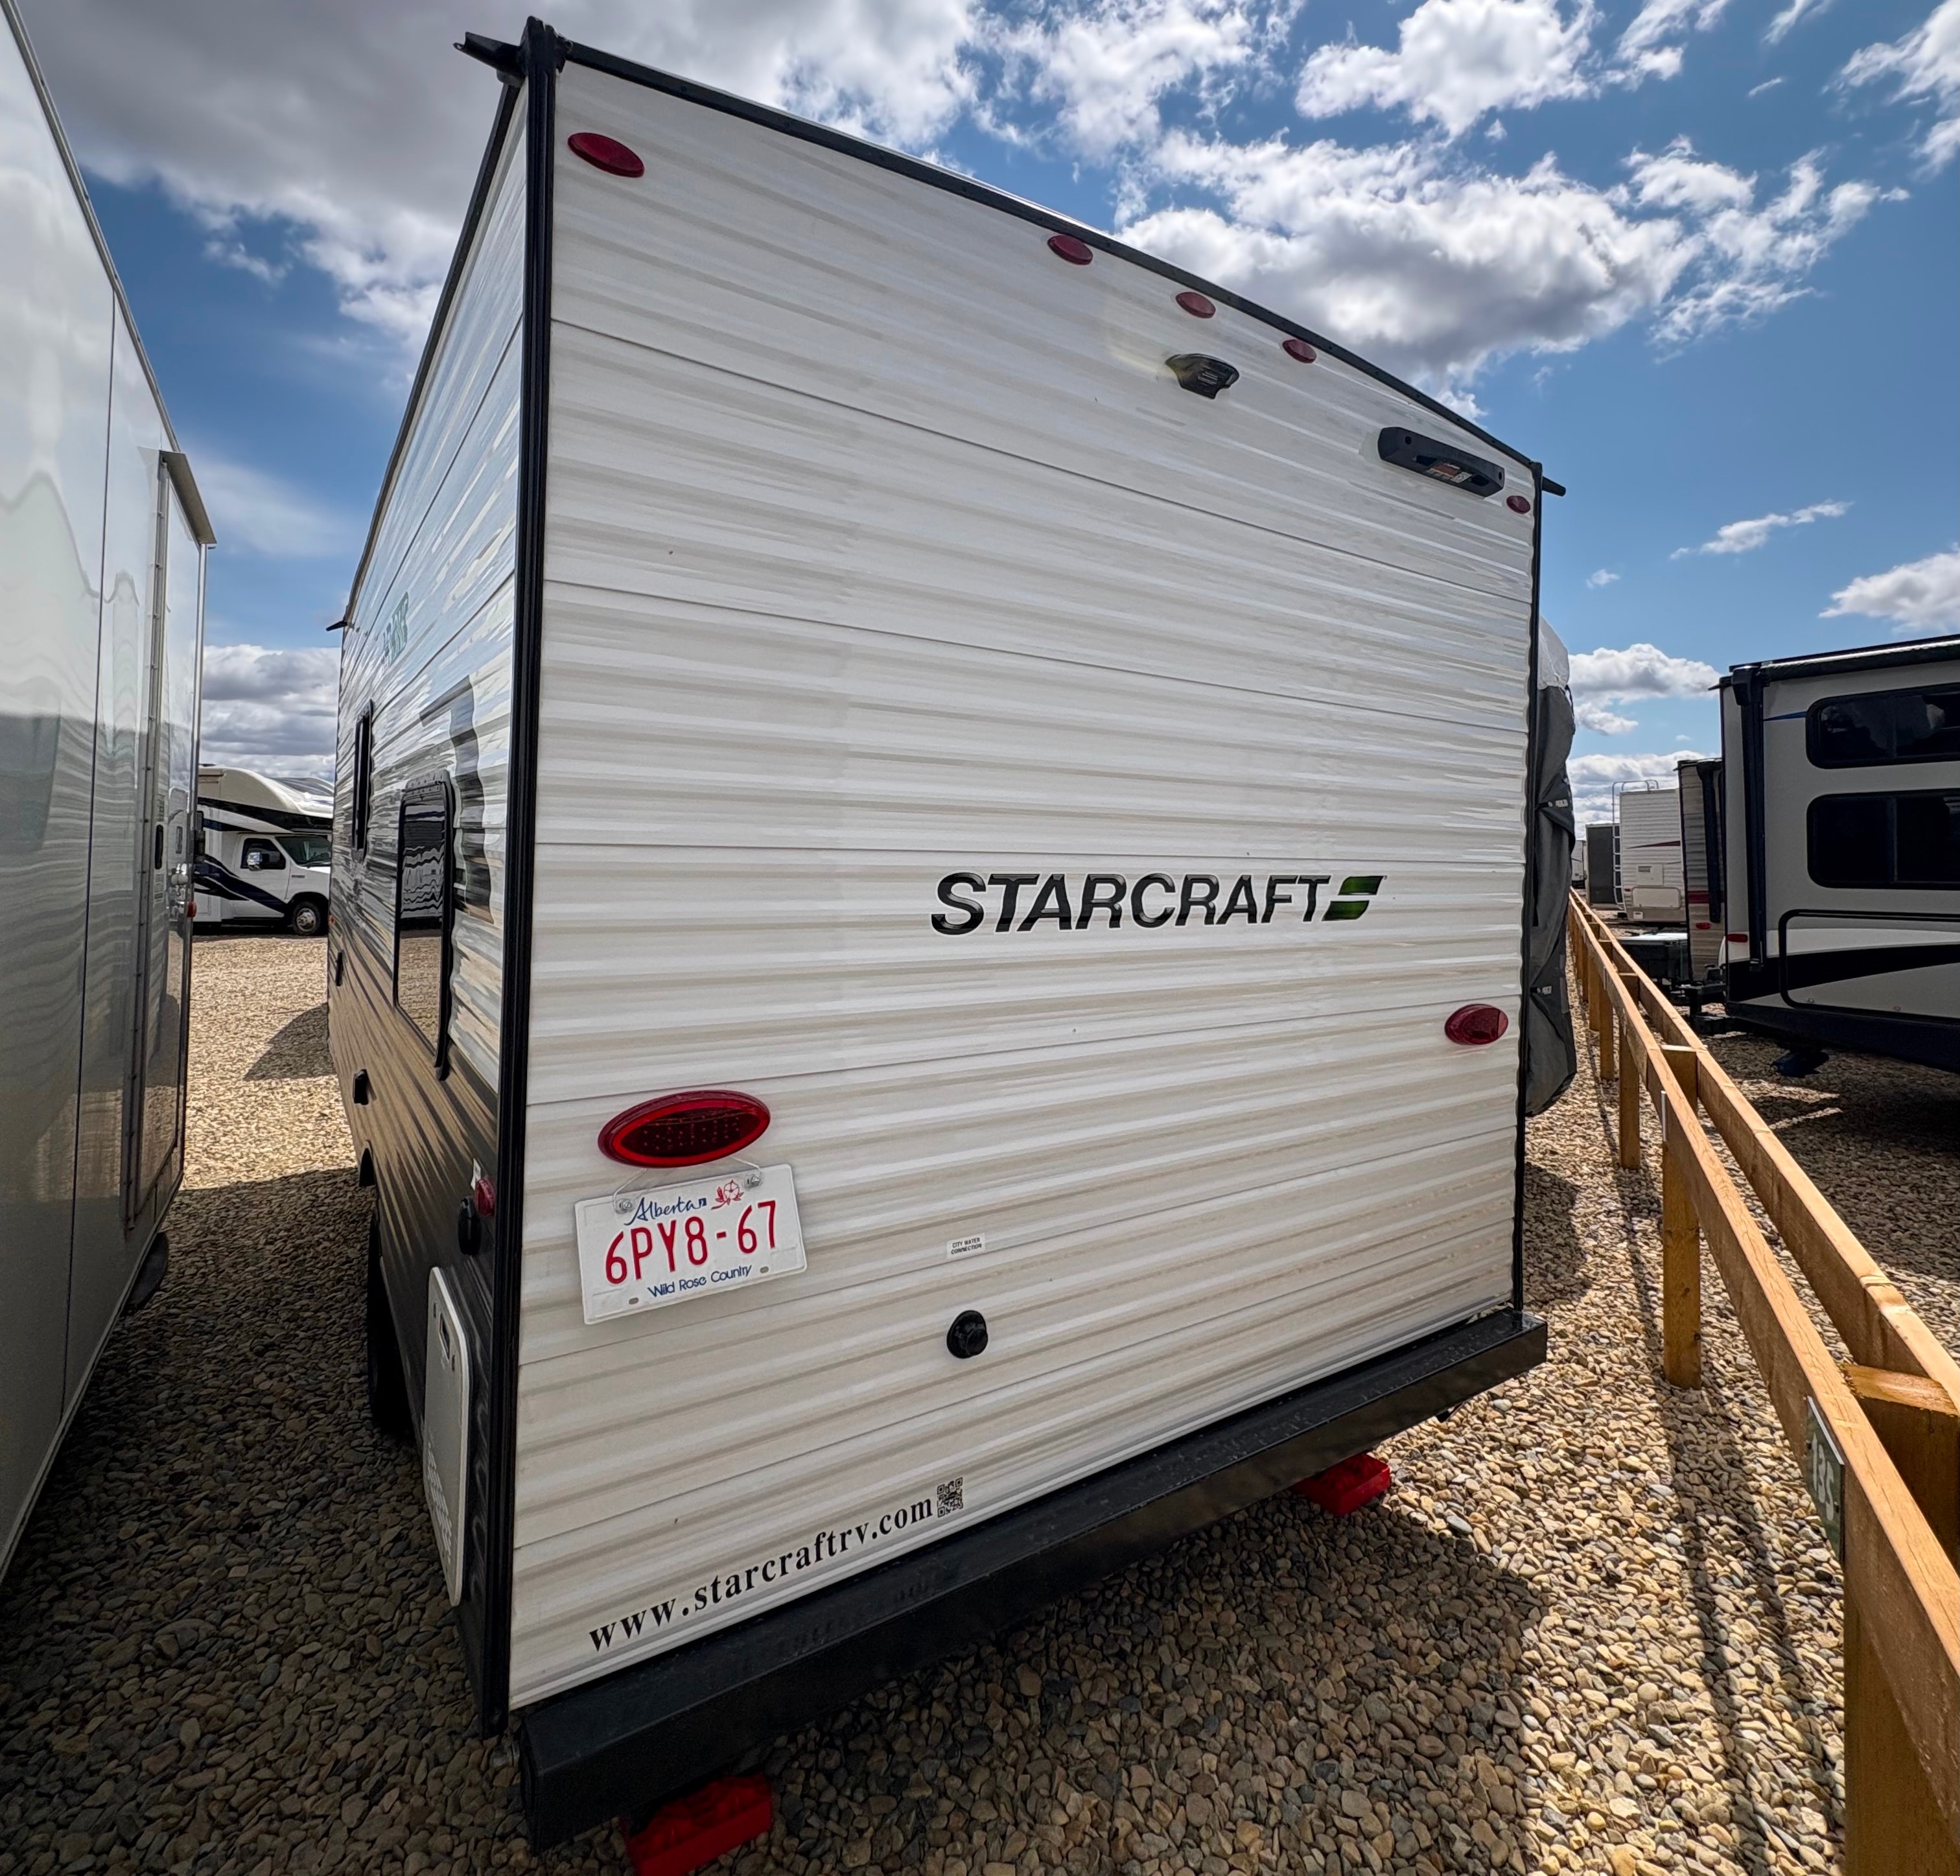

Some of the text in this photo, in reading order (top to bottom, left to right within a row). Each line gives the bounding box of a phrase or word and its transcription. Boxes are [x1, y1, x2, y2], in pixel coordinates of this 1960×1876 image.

[931, 872, 1331, 935] STARCRAFT
[624, 1196, 700, 1226] Alberta
[605, 1200, 776, 1285] 6PY8-67
[950, 1243, 982, 1255] CONNECTION
[964, 1237, 980, 1245] WATER
[648, 1265, 752, 1297] Wild Rose Country
[589, 1498, 933, 1652] www.starcraftrv.com
